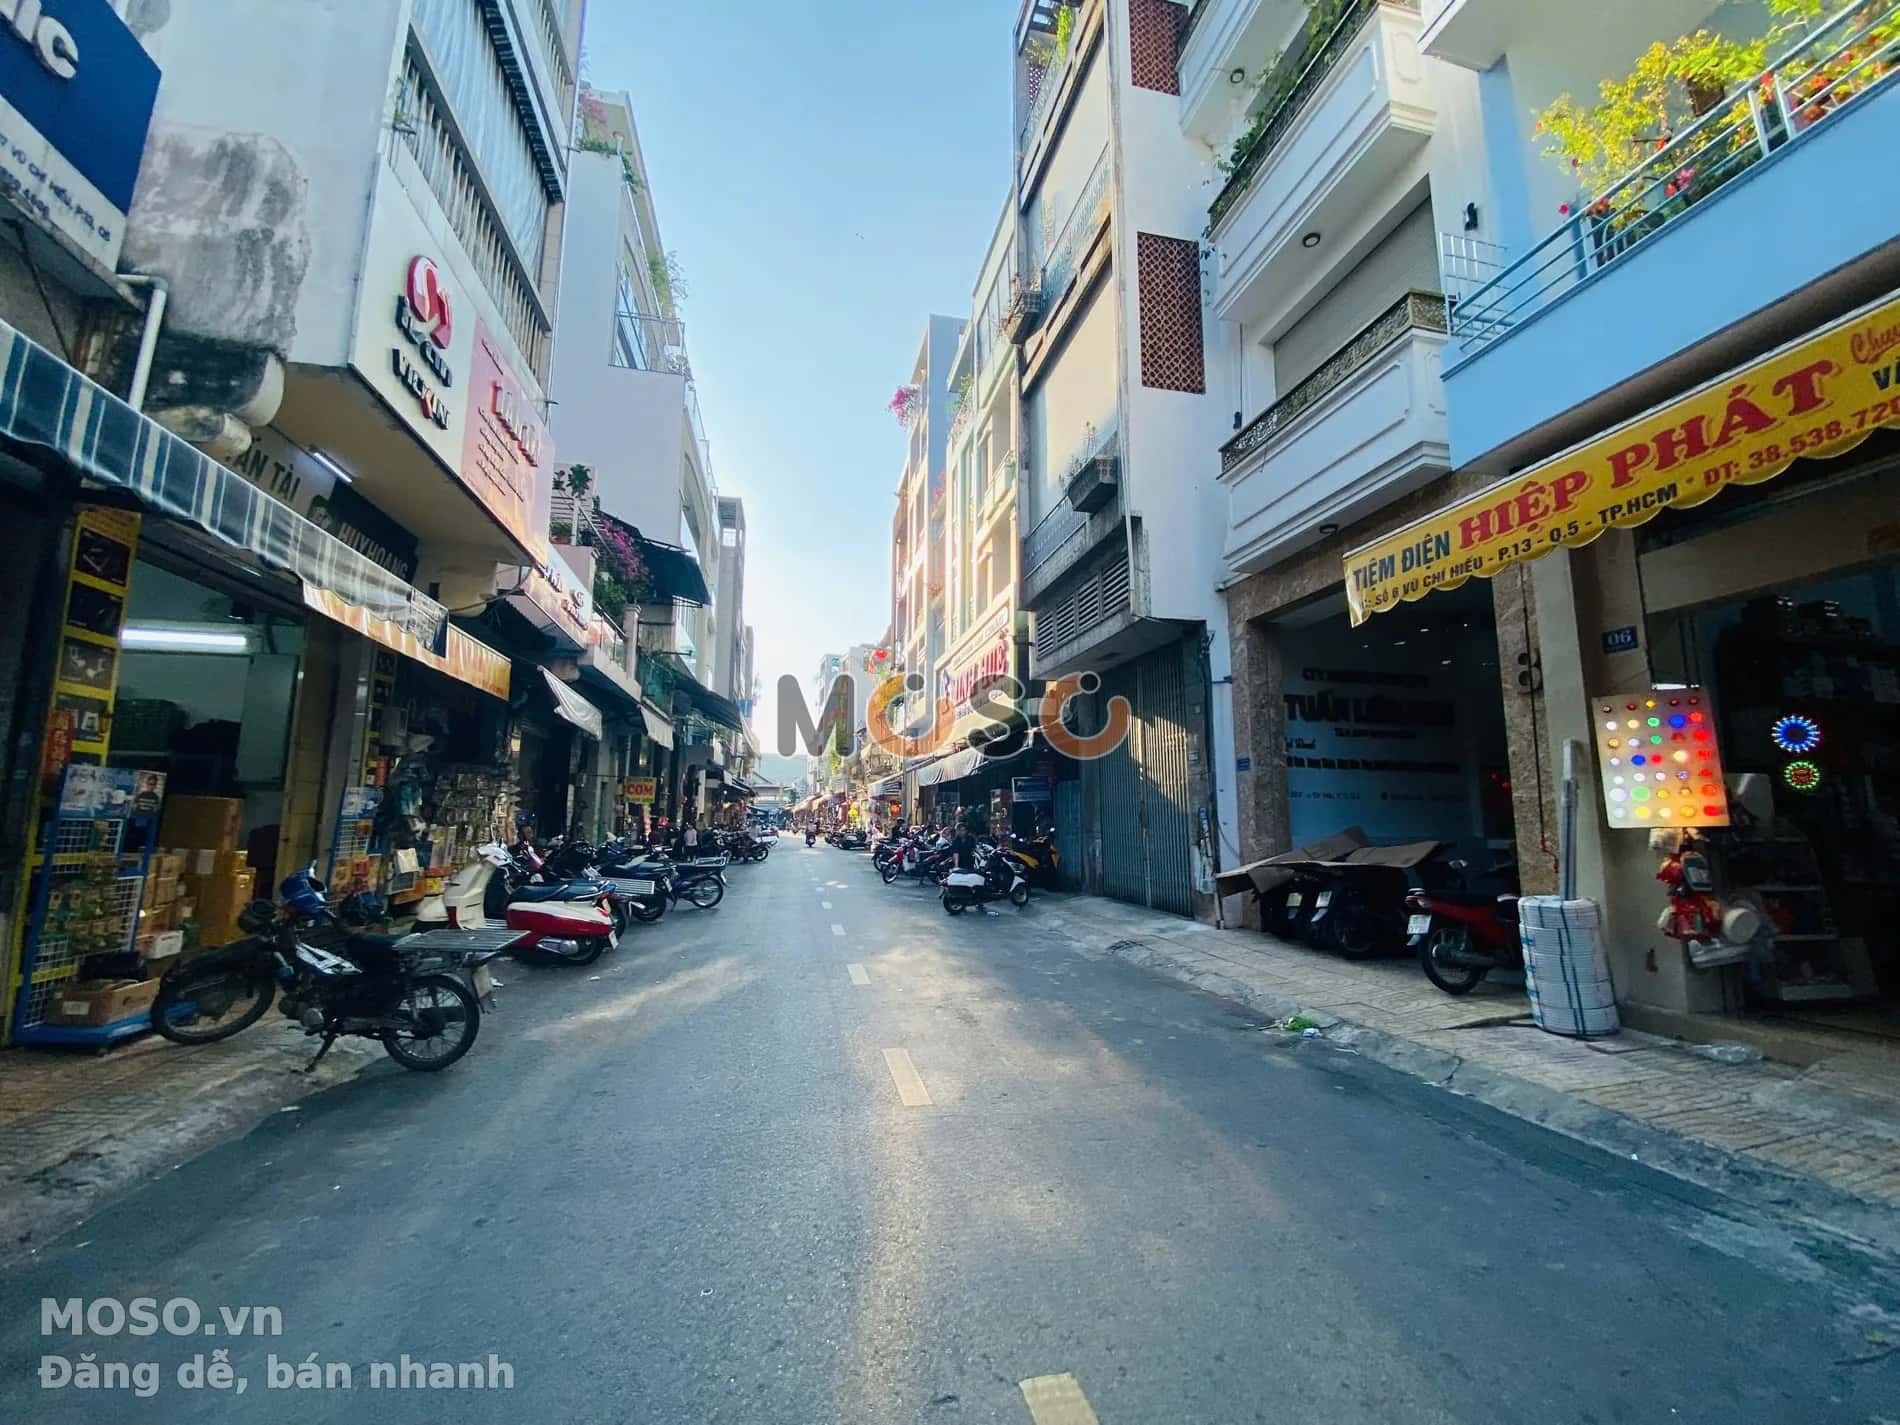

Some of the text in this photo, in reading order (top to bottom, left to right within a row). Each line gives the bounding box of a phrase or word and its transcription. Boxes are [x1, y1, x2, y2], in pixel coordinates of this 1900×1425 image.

[1353, 359, 1836, 592] TIỆM ĐIỆN HIỆP PHÁT
[1598, 483, 1678, 524] TP.HCM
[1607, 630, 1632, 647] 06
